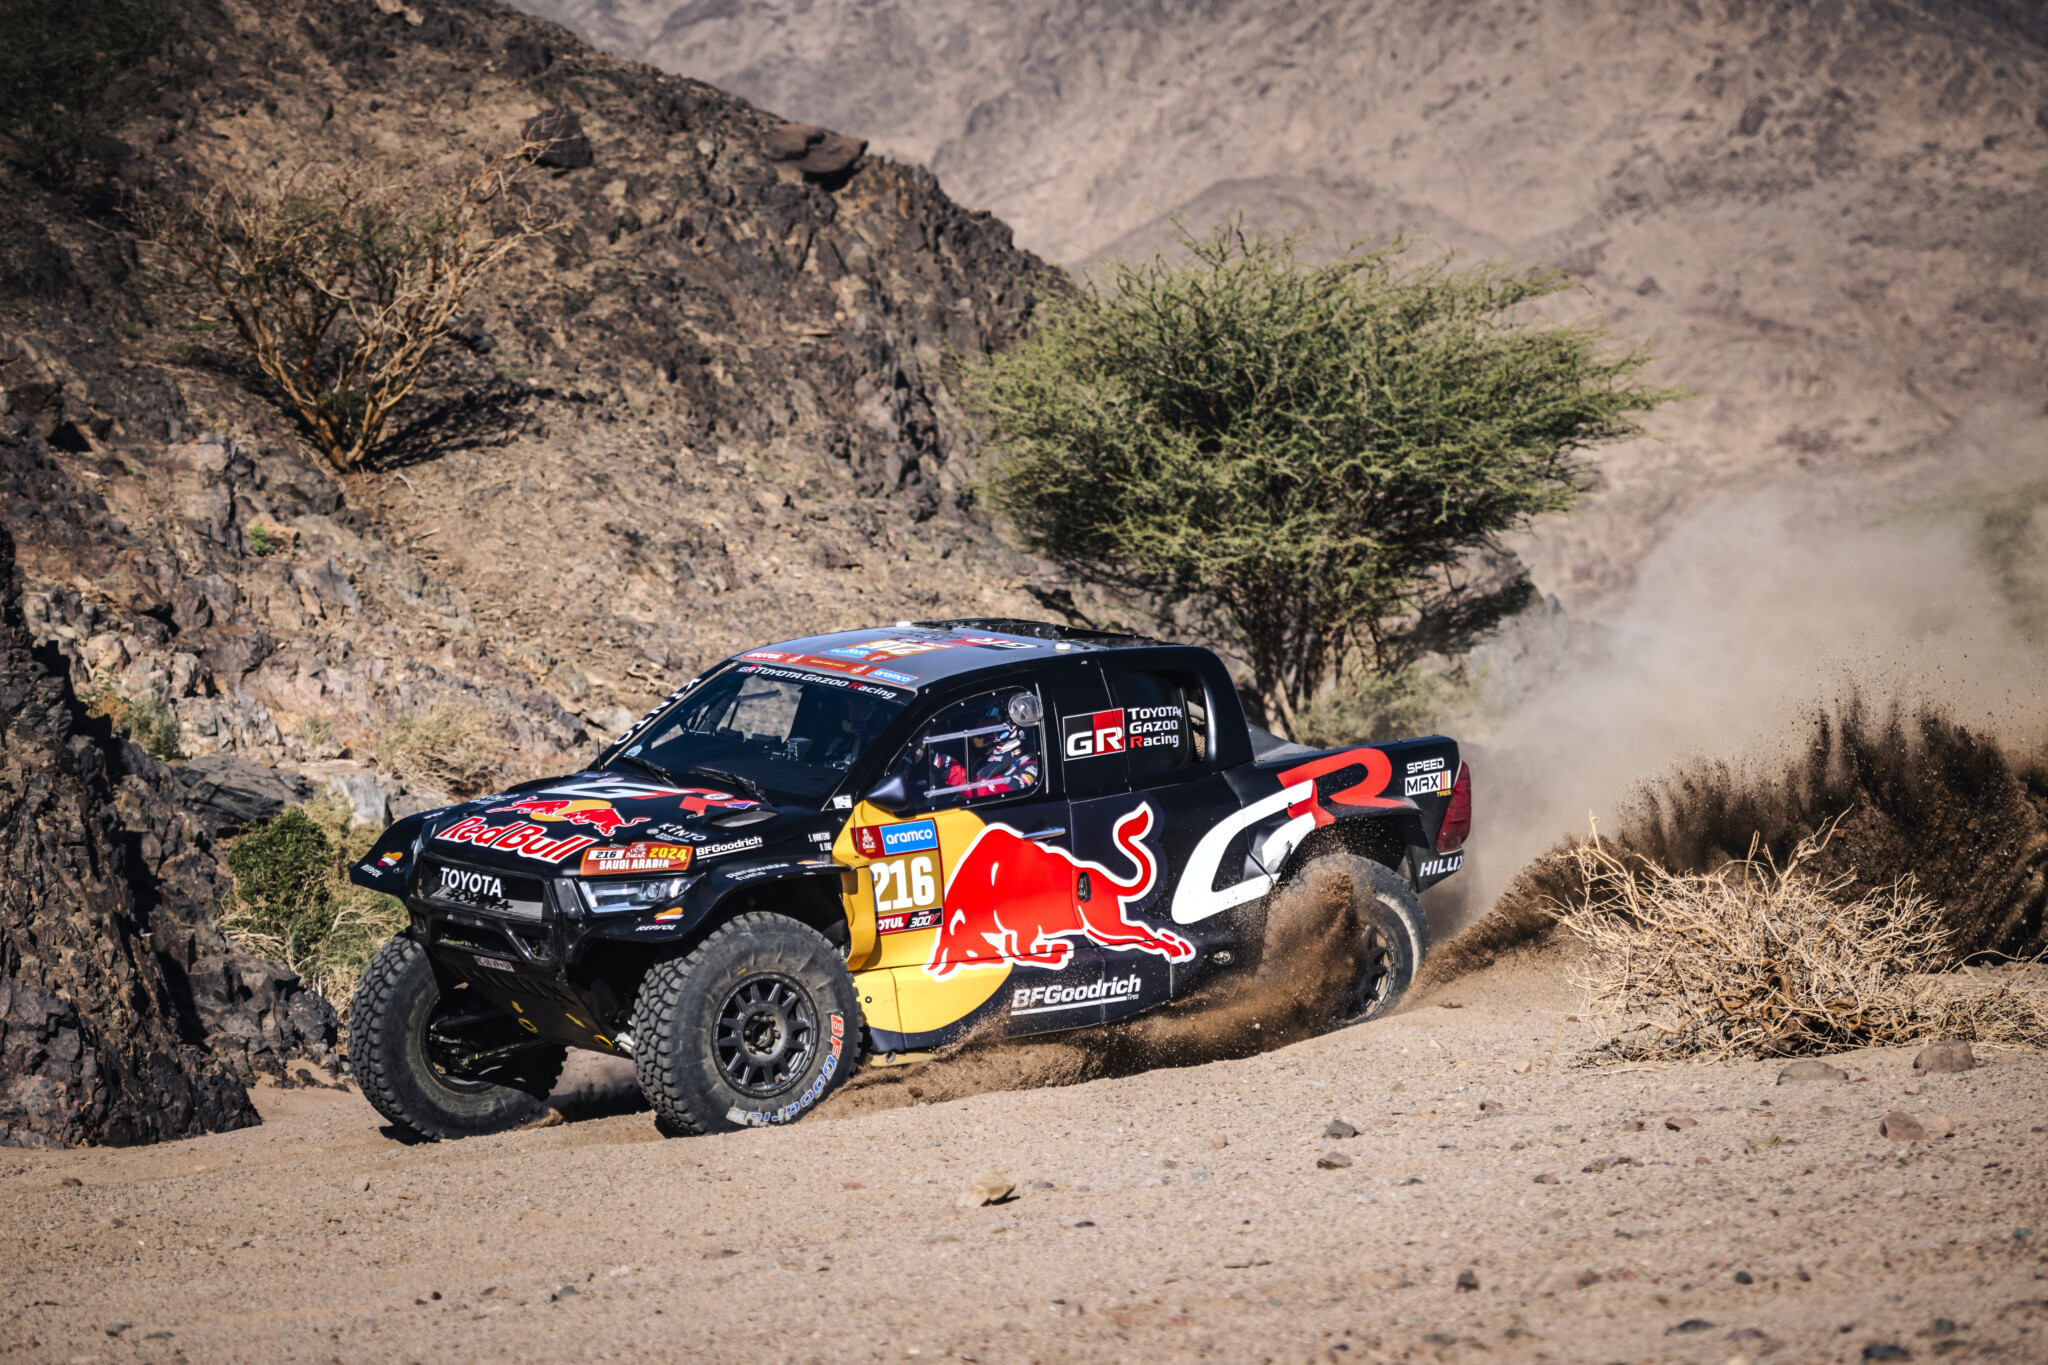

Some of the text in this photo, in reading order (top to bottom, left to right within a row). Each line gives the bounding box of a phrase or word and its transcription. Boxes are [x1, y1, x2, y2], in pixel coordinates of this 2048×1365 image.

[755, 667, 803, 680] TOYOTA
[801, 673, 850, 688] GAZOO
[848, 682, 898, 700] Racing
[874, 668, 911, 683] aramco
[1127, 706, 1178, 720] TOYOTA
[1129, 720, 1178, 734] GAZOO
[1066, 727, 1125, 757] GR
[1130, 732, 1179, 748] Racing
[1406, 757, 1445, 774] SPEED
[1406, 774, 1440, 794] MAX
[886, 829, 933, 845] aramco
[695, 836, 762, 856] BFGoodrich
[595, 851, 617, 859] 216
[649, 847, 687, 862] 2024
[599, 858, 669, 870] SAUDI ARABIA
[440, 867, 503, 898] TOYOTA
[870, 856, 935, 912] 216
[877, 916, 904, 931] OTUL
[1012, 974, 1142, 1008] BFGoodrich
